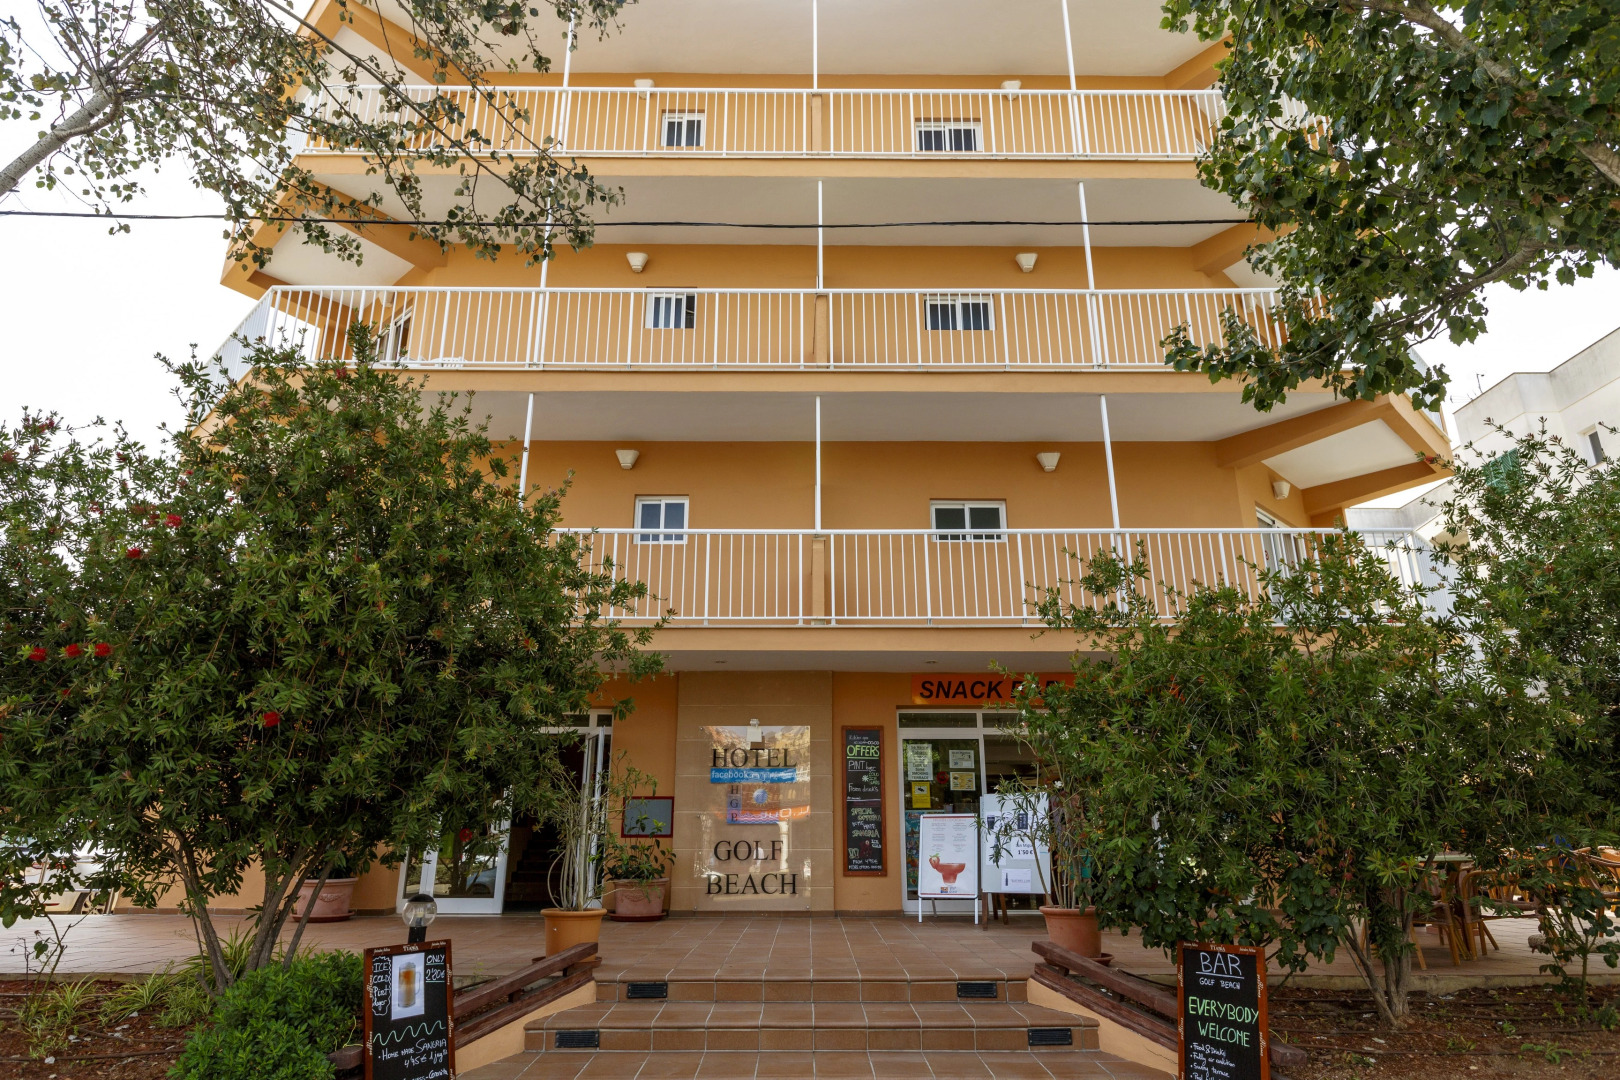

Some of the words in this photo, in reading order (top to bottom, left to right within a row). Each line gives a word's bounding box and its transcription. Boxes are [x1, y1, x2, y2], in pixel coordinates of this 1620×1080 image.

[919, 680, 1003, 699] SNACK
[711, 748, 797, 768] HOTEL
[847, 745, 880, 757] OFFERS
[848, 760, 866, 770] PINT
[714, 840, 783, 861] GOLF
[705, 873, 798, 895] BEACH
[373, 962, 389, 972] ICE
[426, 954, 445, 964] ONLY
[1200, 952, 1242, 976] BAR
[372, 974, 390, 983] COLD
[1199, 977, 1215, 986] GOLF
[1220, 980, 1241, 990] BEACH
[1188, 996, 1259, 1025] EVERYBODY
[1198, 1020, 1250, 1048] WELCOME
[415, 1038, 447, 1054] SANGRIA
